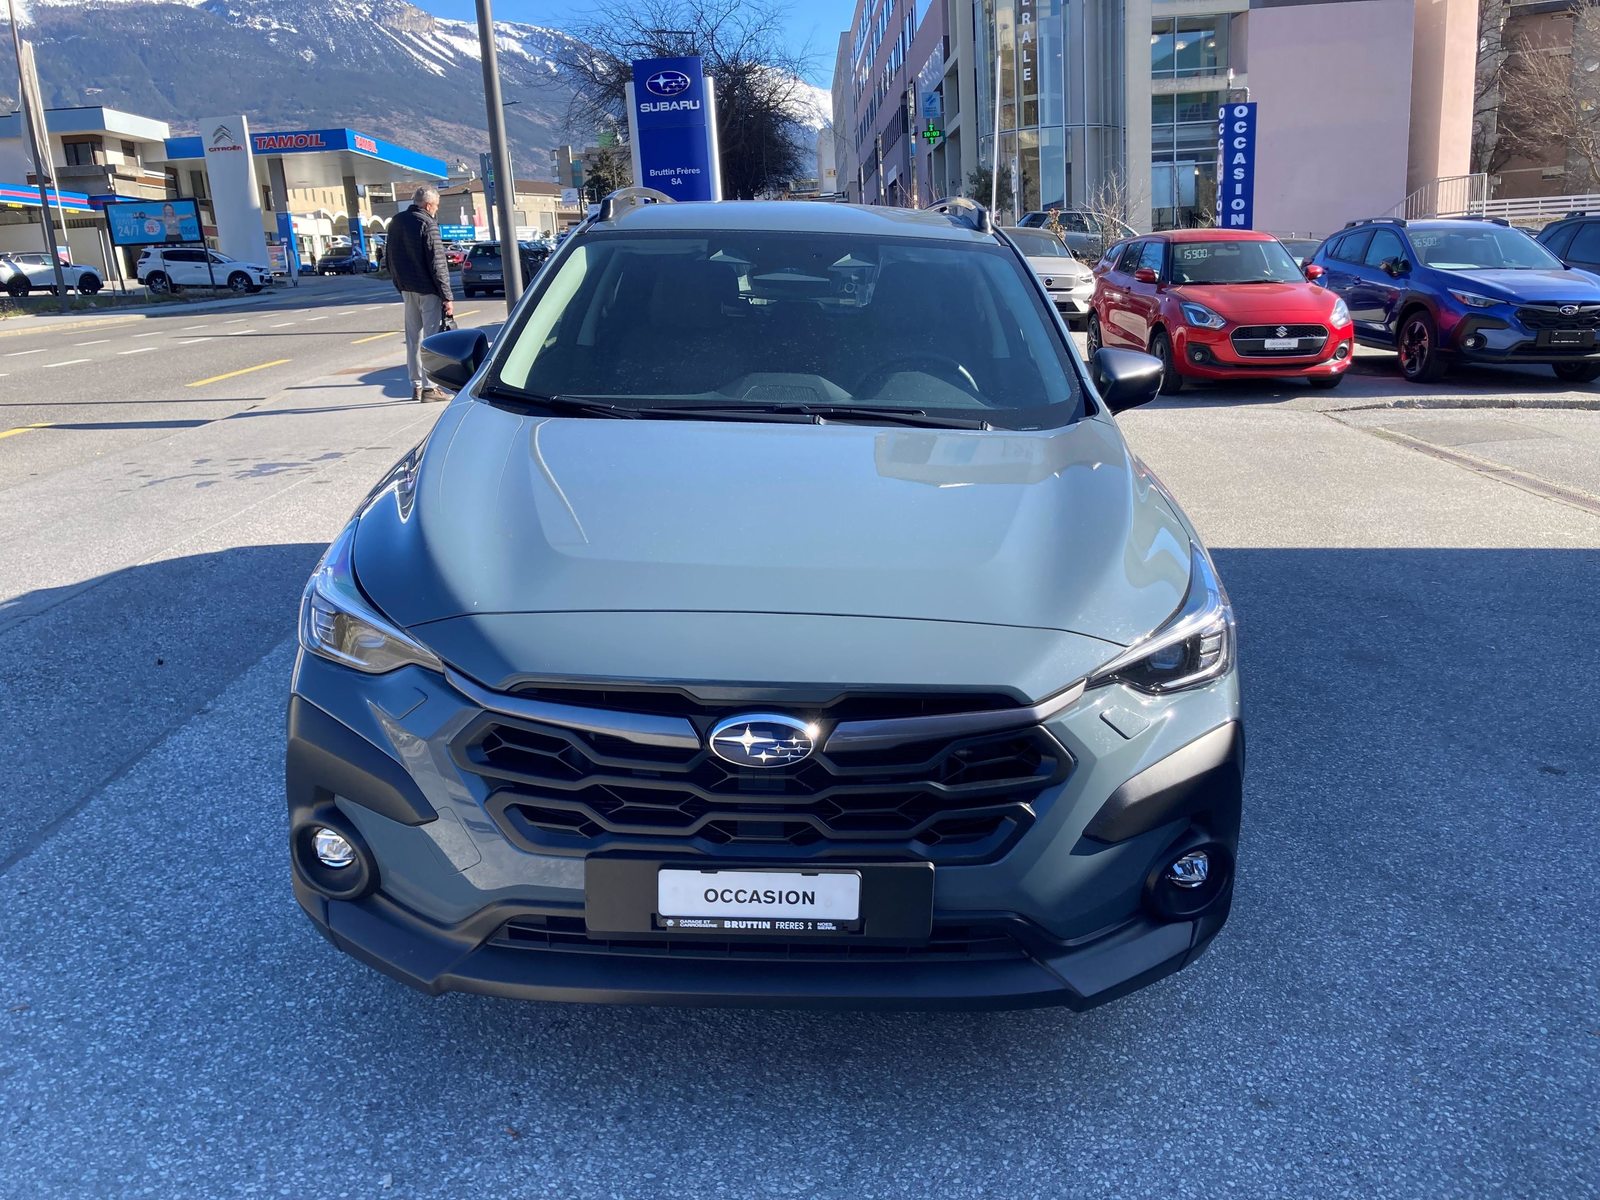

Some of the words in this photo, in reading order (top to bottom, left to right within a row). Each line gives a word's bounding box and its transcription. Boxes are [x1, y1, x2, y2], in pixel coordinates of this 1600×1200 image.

[640, 100, 700, 112] SUBARU
[254, 134, 326, 150] TAMOIL
[354, 134, 379, 154] TAMOIL
[649, 169, 675, 177] Bruttin
[676, 167, 701, 175] Frères
[1216, 107, 1225, 227] OCCASION
[1231, 105, 1248, 226] OCCASION
[671, 177, 683, 185] SA
[703, 888, 816, 905] OCCASION
[723, 920, 771, 929] BRUTTIN
